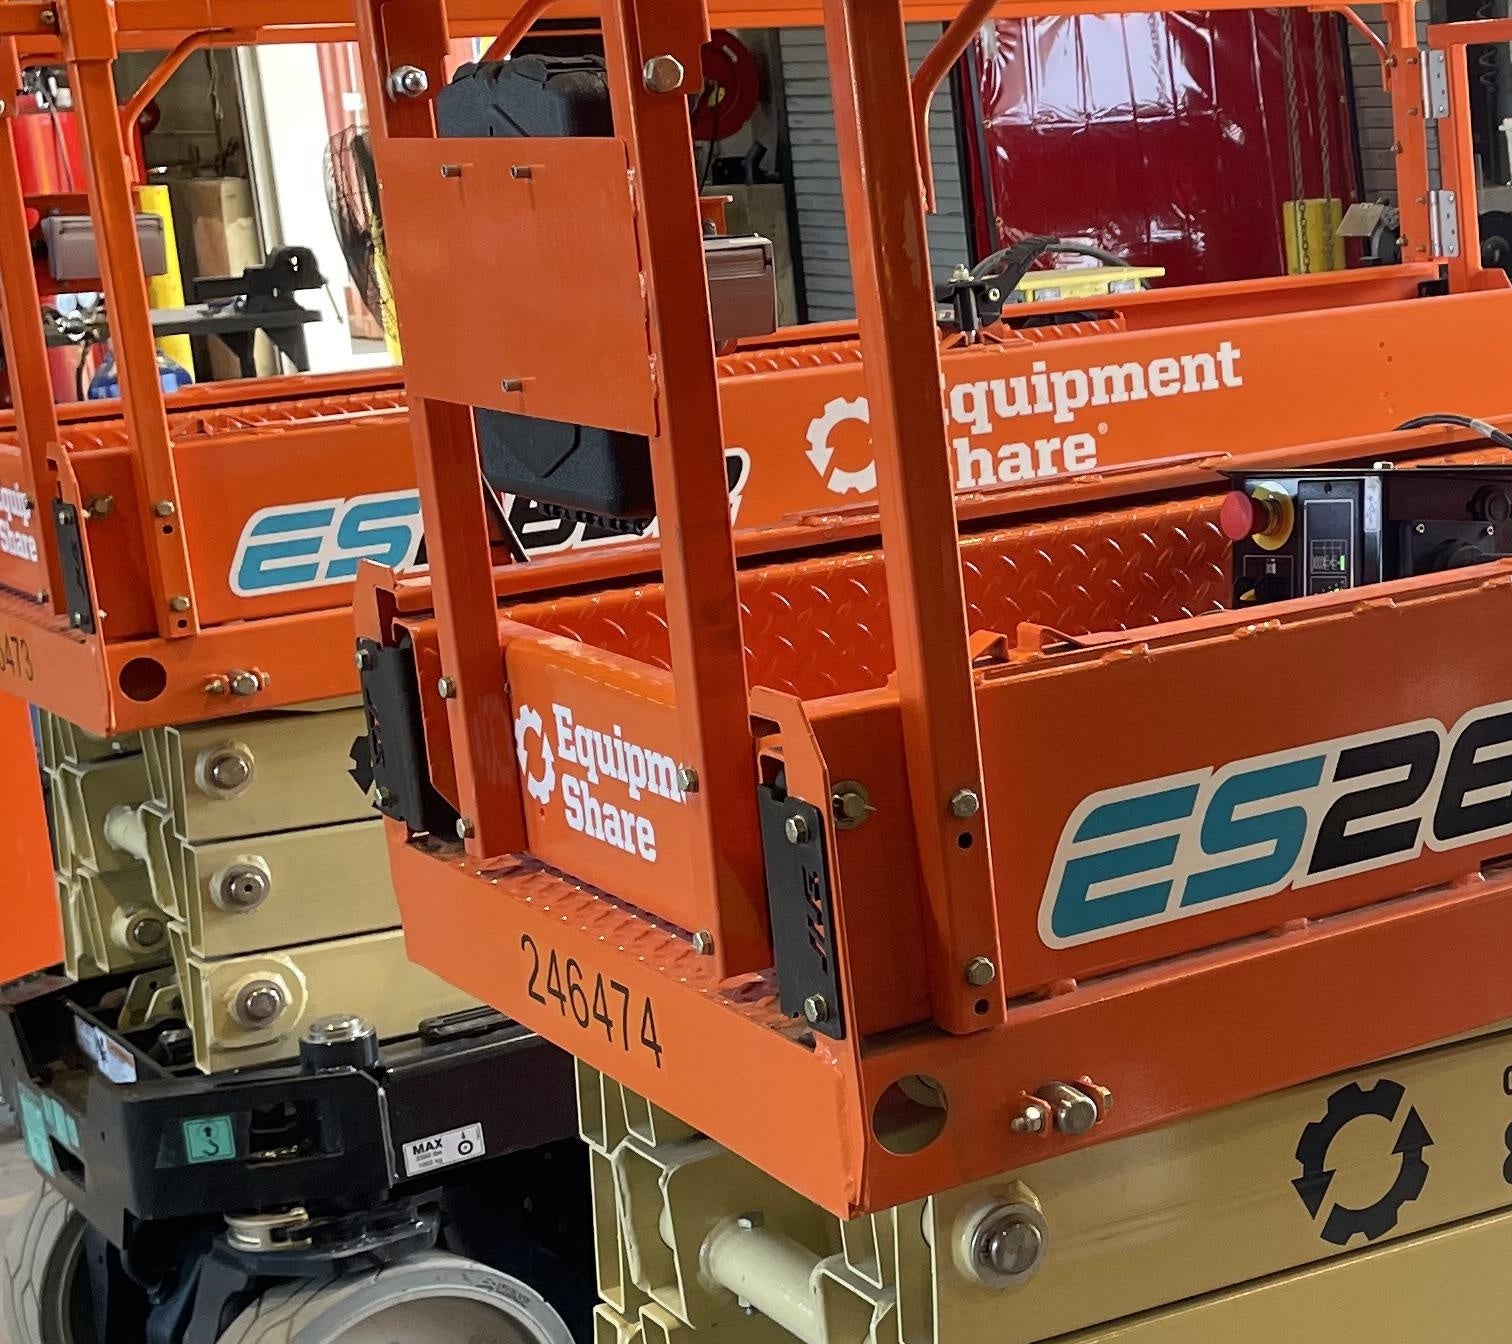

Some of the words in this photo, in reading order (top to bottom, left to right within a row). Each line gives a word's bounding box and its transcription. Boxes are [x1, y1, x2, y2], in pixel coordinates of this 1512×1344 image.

[941, 341, 1242, 435] quipment
[952, 432, 1097, 489] hare
[552, 703, 687, 804] Equipm
[561, 773, 656, 863] Share
[520, 934, 662, 1069] 246474
[412, 1138, 443, 1155] MAX
